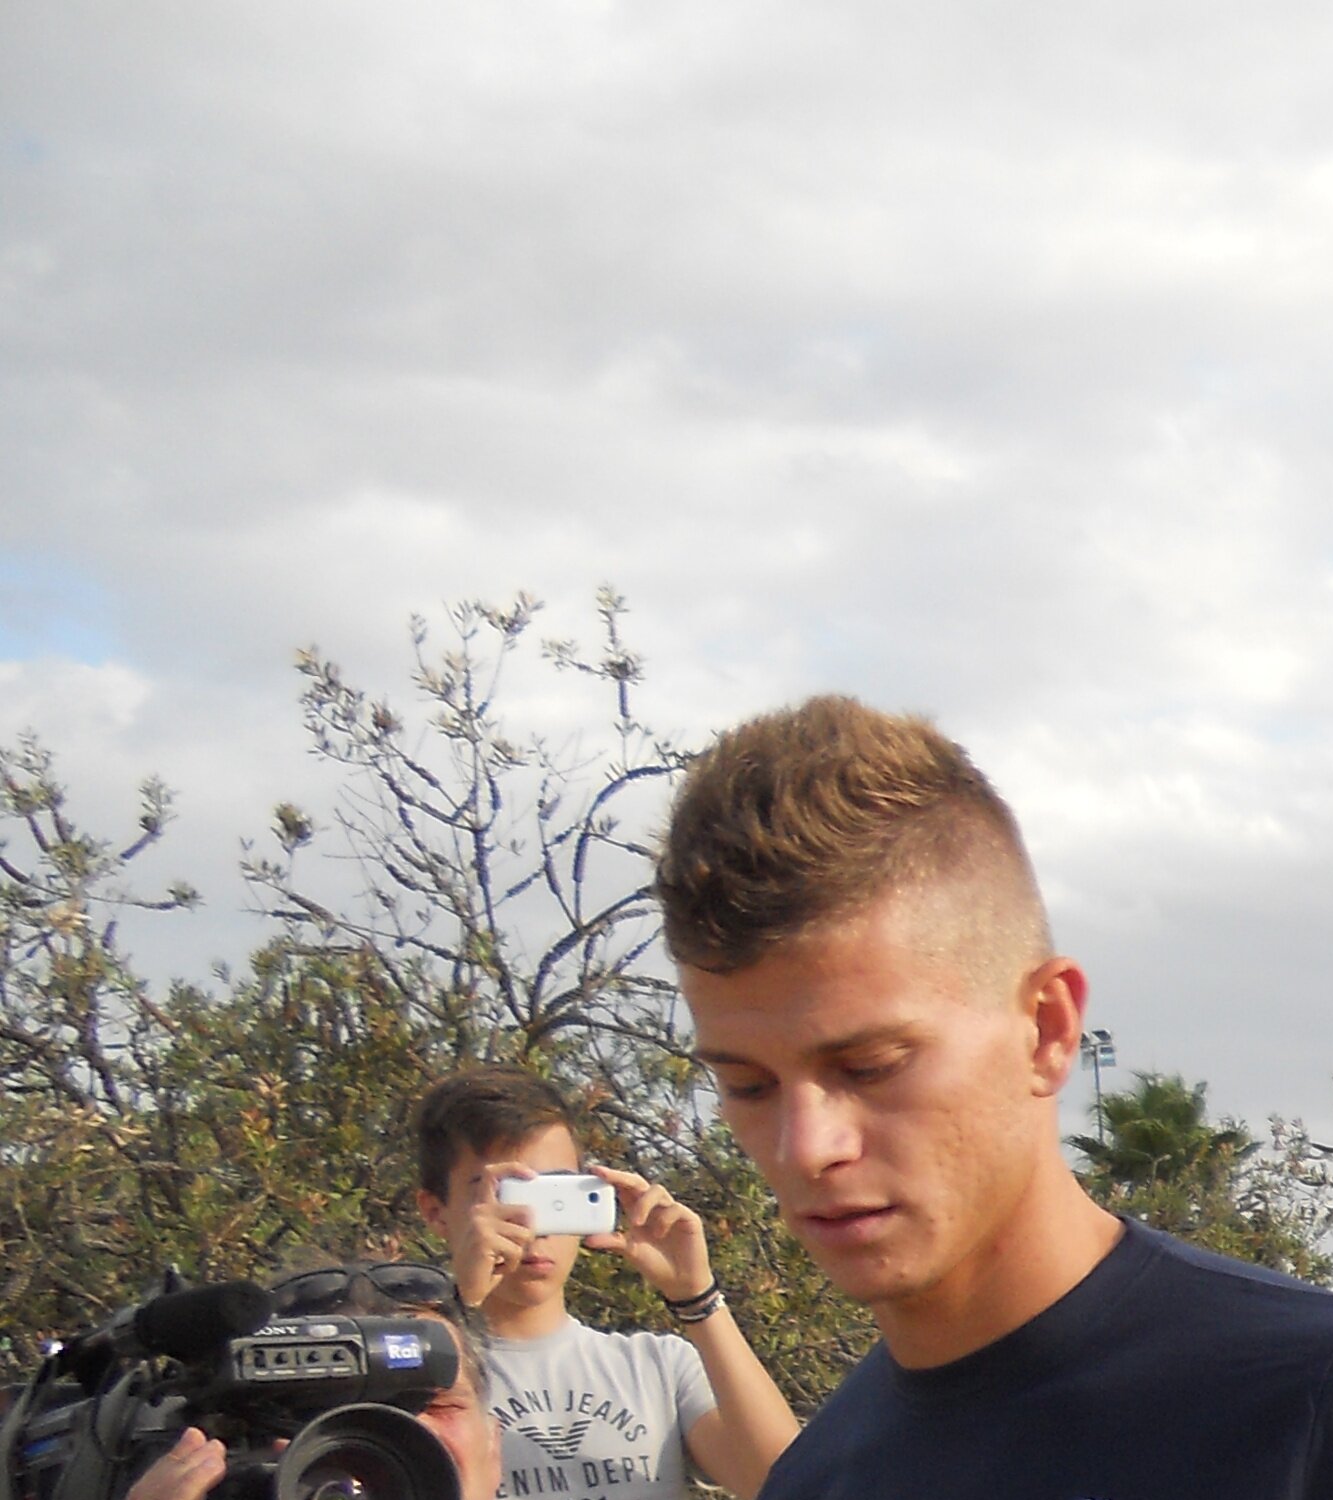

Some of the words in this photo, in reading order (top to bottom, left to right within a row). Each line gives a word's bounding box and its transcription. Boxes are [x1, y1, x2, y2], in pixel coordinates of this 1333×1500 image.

[388, 1343, 420, 1360] Rai
[492, 1389, 552, 1430] MANI
[565, 1389, 648, 1442] JEANS
[582, 1455, 660, 1488] DEPT.
